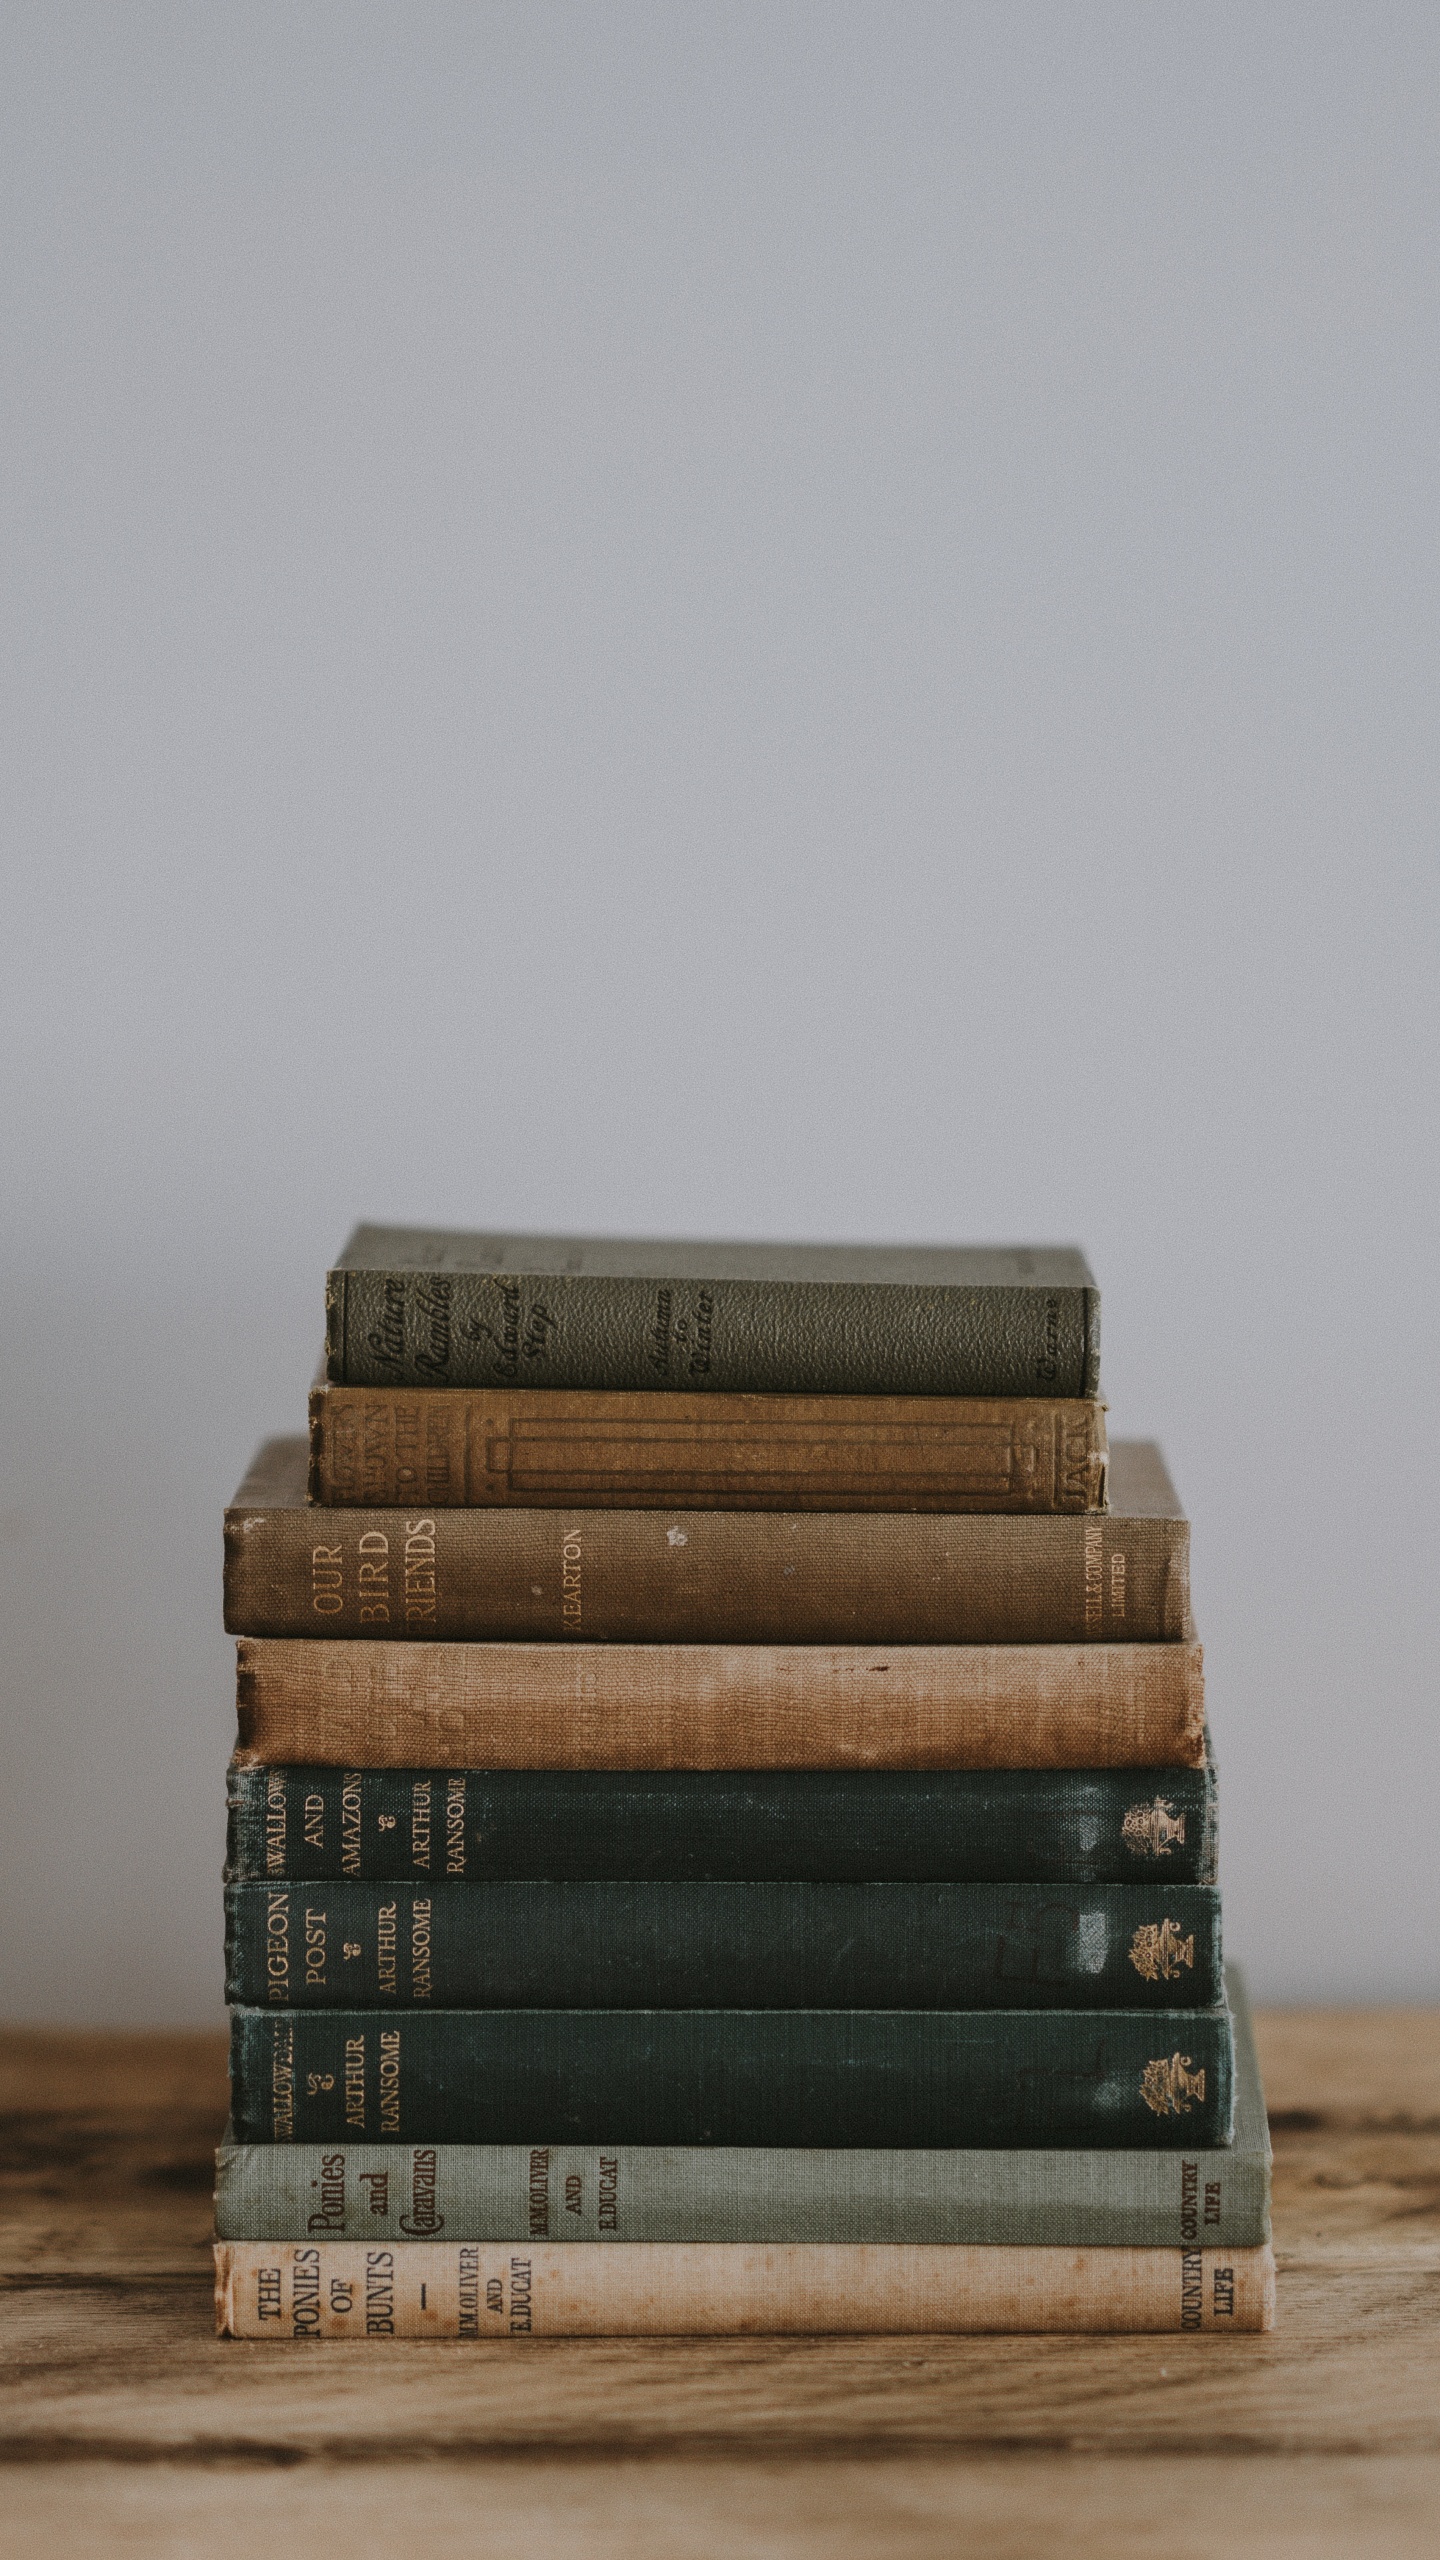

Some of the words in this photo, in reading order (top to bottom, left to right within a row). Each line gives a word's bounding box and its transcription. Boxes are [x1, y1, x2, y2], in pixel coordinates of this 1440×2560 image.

[368, 1278, 407, 1378] Nature
[414, 1277, 451, 1380] Rambles
[458, 1315, 492, 1342] by
[493, 1277, 521, 1378] Edward
[521, 1304, 558, 1358] Step
[648, 1288, 671, 1377] Autumn
[672, 1318, 688, 1343] to
[688, 1290, 713, 1376] Winter
[1035, 1298, 1058, 1381] Warne
[1060, 1411, 1091, 1501] JACK
[312, 1543, 344, 1615] OUR
[359, 1531, 390, 1624] BIRD
[563, 1529, 582, 1631] KEARTON
[1085, 1525, 1103, 1582] COMPANY
[1085, 1583, 1103, 1594] &
[1111, 1553, 1126, 1617] LIMITED
[303, 1794, 325, 1849] AND
[342, 1772, 362, 1877] AMAZONS
[412, 1780, 431, 1869] ARTHUR
[446, 1777, 467, 1873] RANSOME
[267, 1891, 289, 2002] PIGEON
[305, 1908, 327, 1985] POST
[378, 1901, 397, 1994] ARTHUR
[412, 1898, 433, 1998] RANSOME
[345, 2034, 365, 2128] ARTHUR
[380, 2030, 400, 2132] RANSOME
[307, 2153, 346, 2234] Ponies
[359, 2170, 389, 2217] and
[398, 2149, 445, 2236] Caravans
[565, 2175, 582, 2216] AND
[1180, 2159, 1198, 2240] COUNTRY
[1204, 2182, 1221, 2226] LIFE
[257, 2268, 282, 2321] THE
[292, 2248, 321, 2338] PONIES
[330, 2278, 353, 2314] OF
[365, 2252, 395, 2335] BUNTS
[486, 2278, 504, 2315] AND
[510, 2257, 532, 2333] E.DUCAT
[1181, 2245, 1203, 2330] COUNTRY
[1213, 2268, 1234, 2317] LIFE
